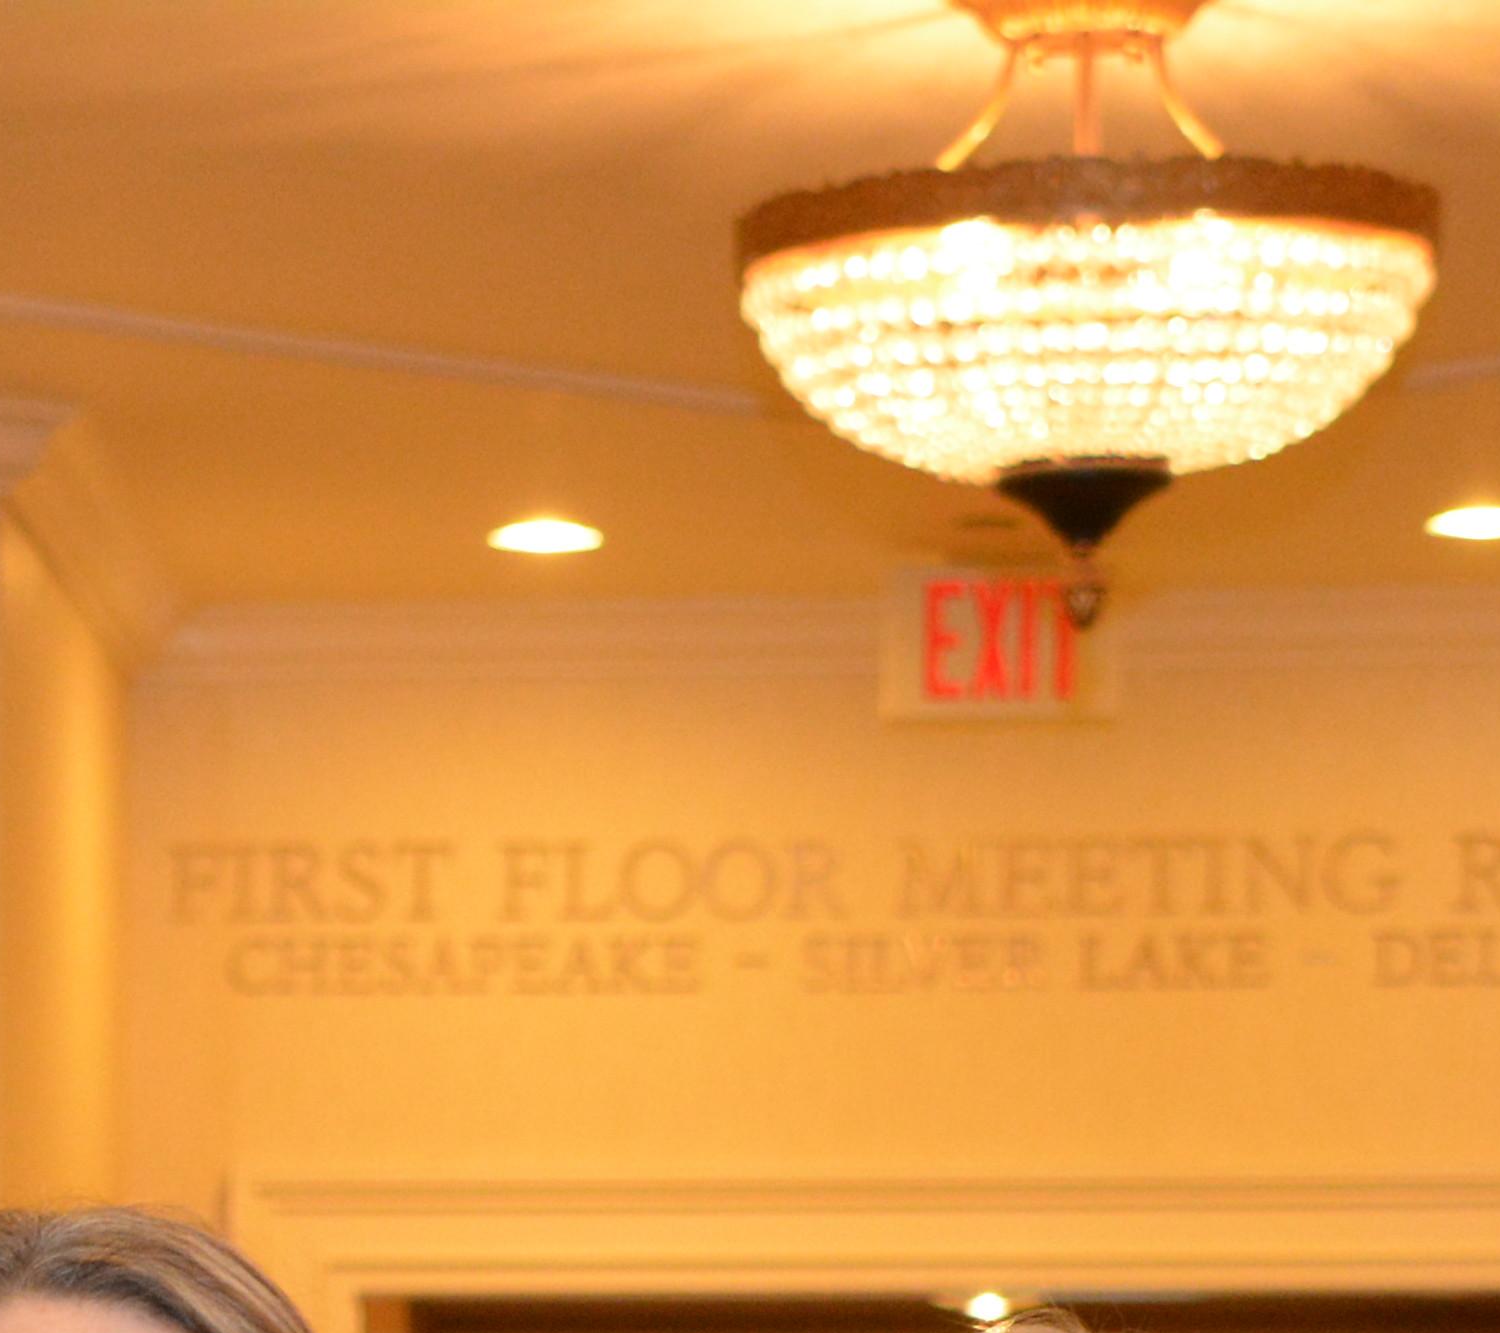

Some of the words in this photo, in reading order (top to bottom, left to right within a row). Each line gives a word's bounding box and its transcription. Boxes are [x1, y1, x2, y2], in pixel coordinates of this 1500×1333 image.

[924, 580, 1080, 700] EXIT
[168, 839, 454, 925] FIRST
[502, 837, 846, 923] FLOOR
[896, 830, 1402, 920] MEETING
[222, 932, 701, 996] CHESAPEAKE
[803, 932, 1047, 994] SILVER
[1075, 929, 1268, 991] LAKE
